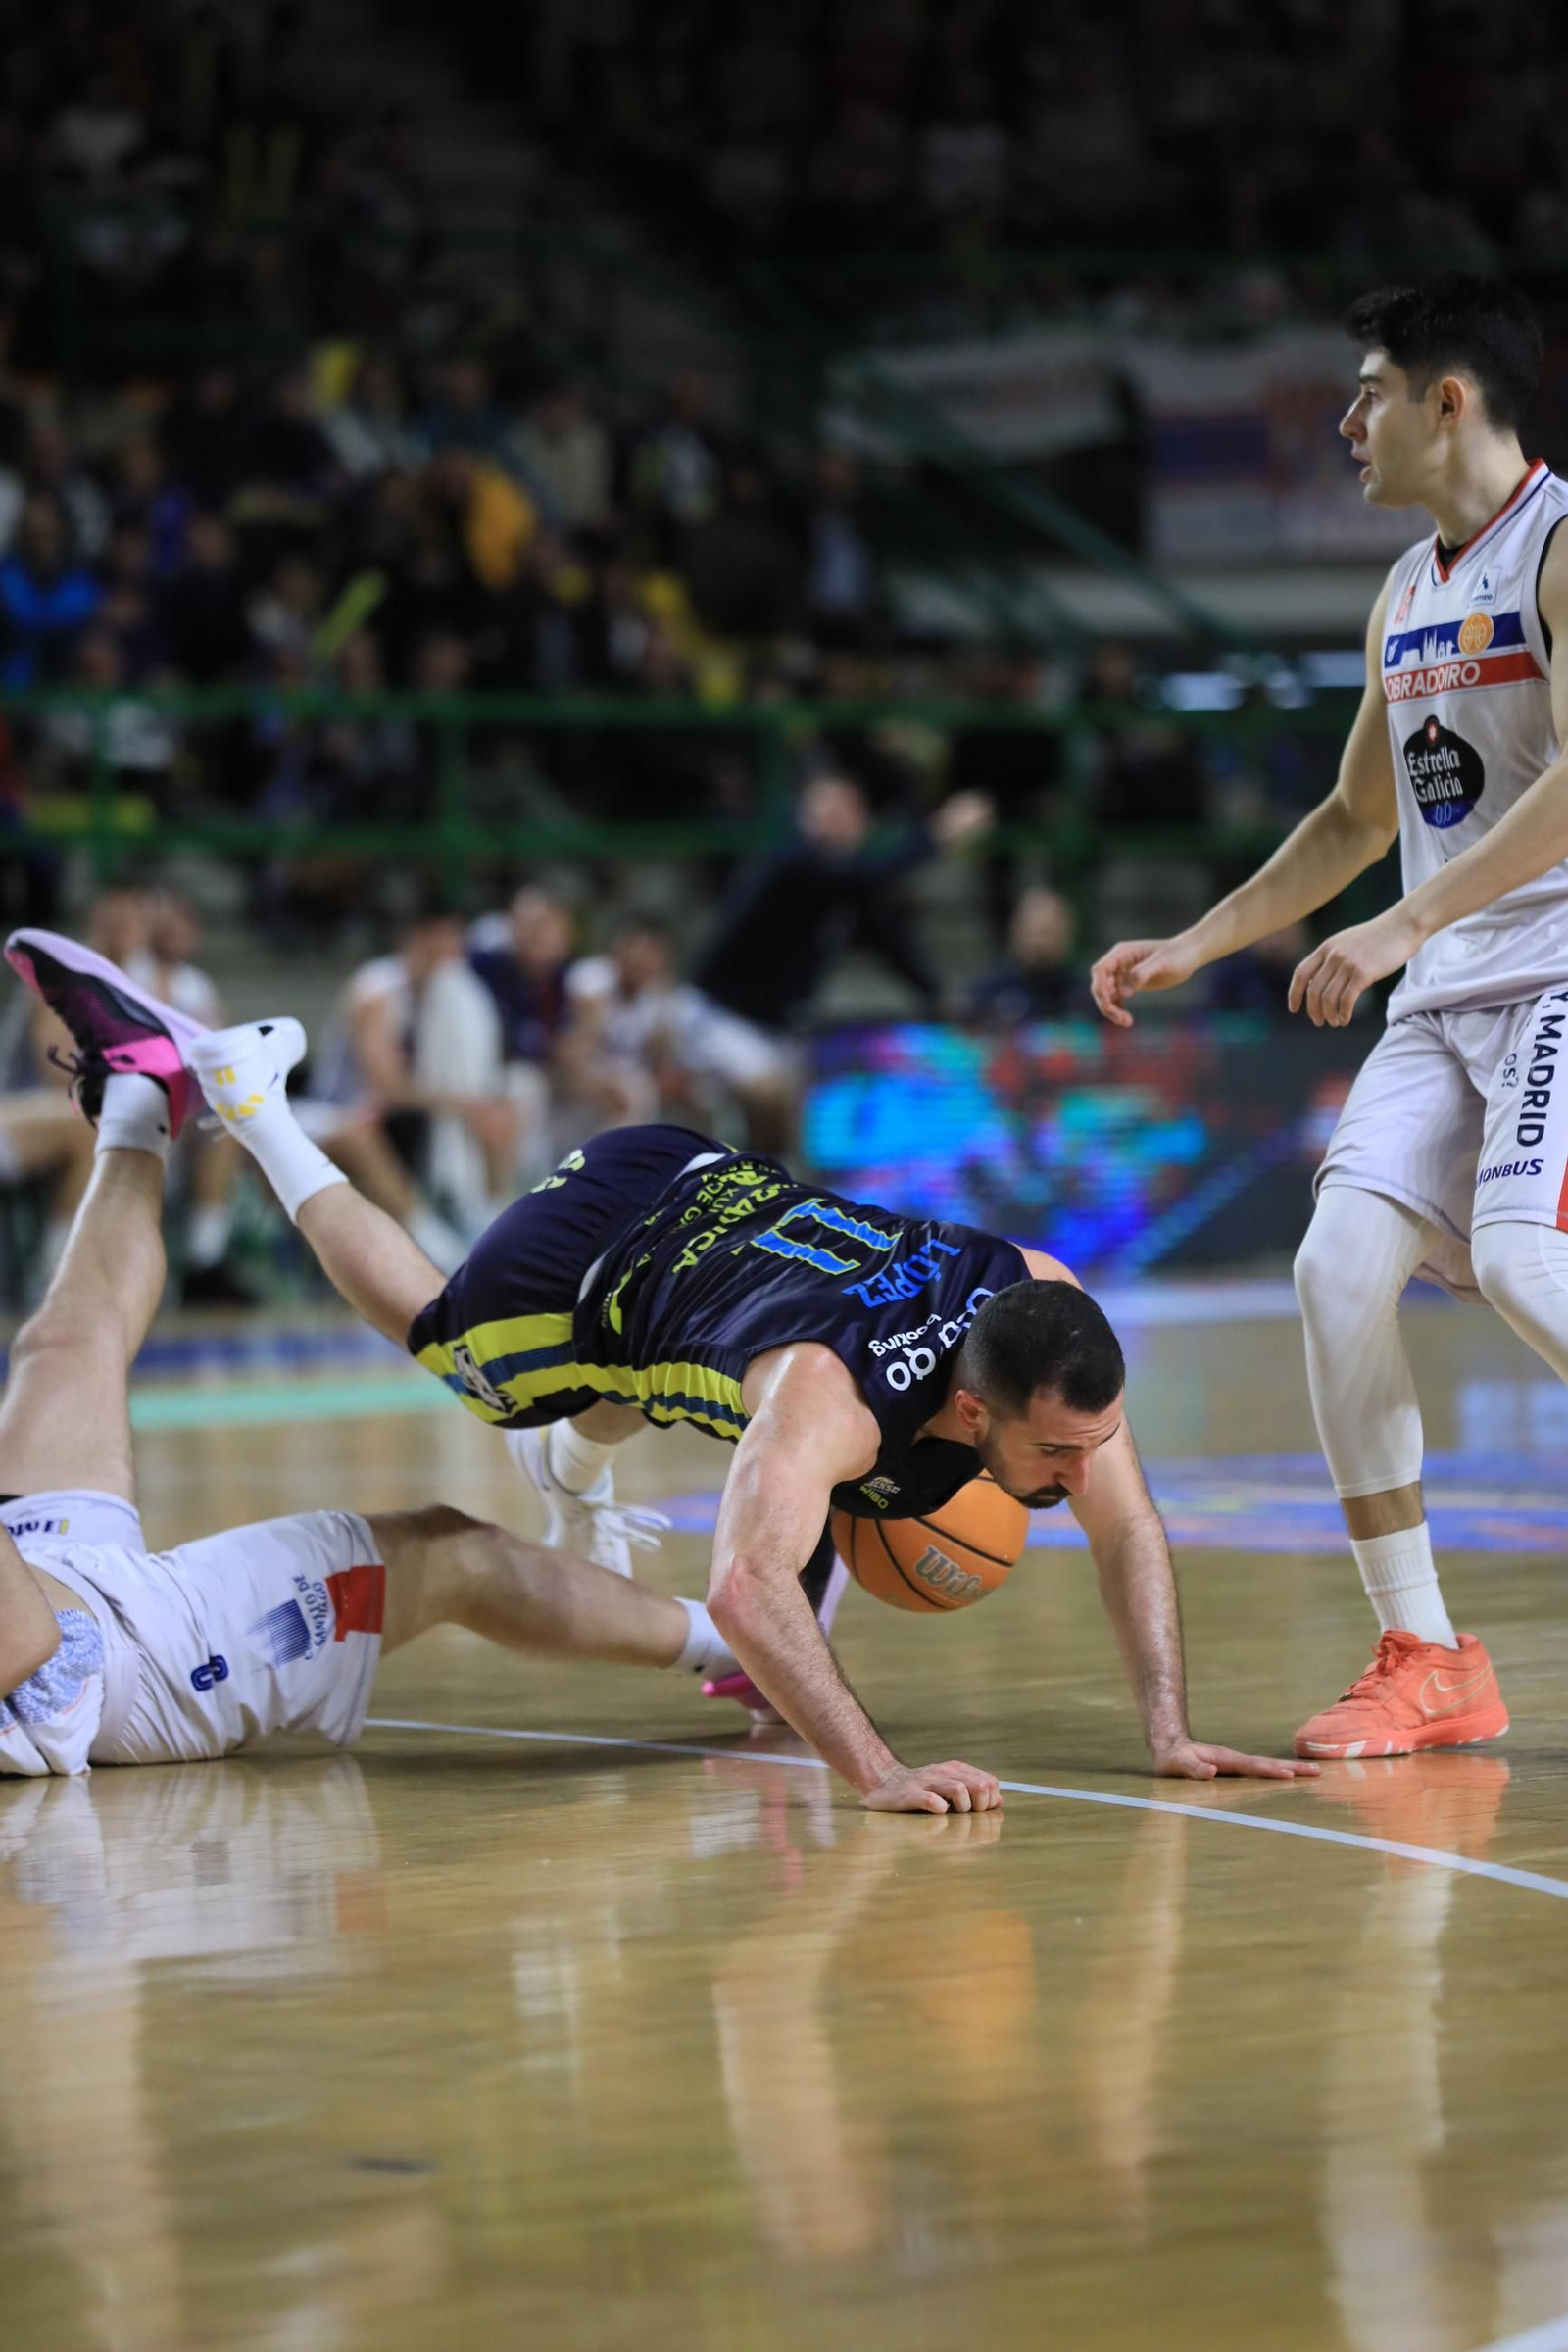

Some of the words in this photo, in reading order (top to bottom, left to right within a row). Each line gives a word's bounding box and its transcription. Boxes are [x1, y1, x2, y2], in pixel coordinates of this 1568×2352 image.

[1387, 661, 1481, 703] OBRADOIRO
[1407, 746, 1461, 776] Estrella
[1413, 772, 1464, 804] Galicia
[1516, 1014, 1566, 1148] MADRID
[841, 1238, 962, 1309] LÓPEZ
[867, 1313, 942, 1358] booking
[859, 1484, 889, 1510] WIBO
